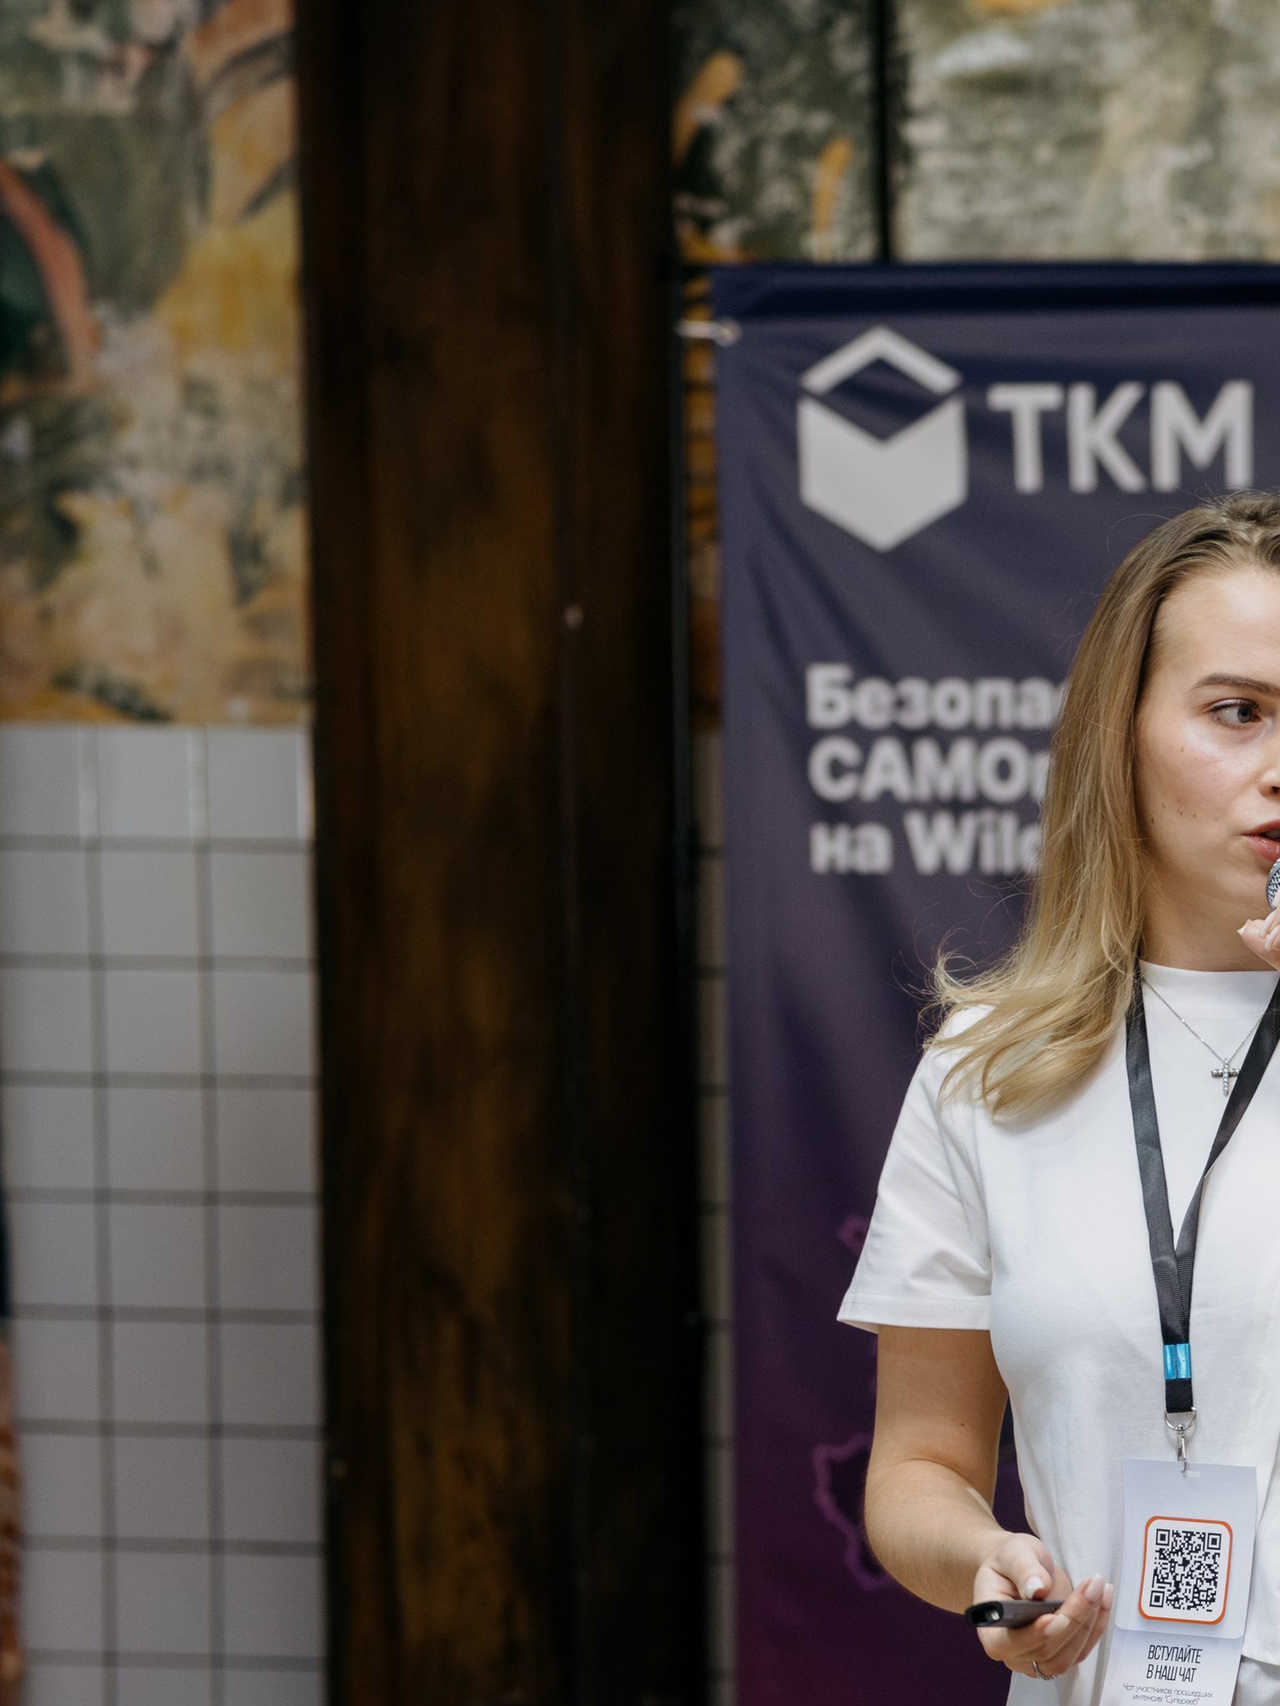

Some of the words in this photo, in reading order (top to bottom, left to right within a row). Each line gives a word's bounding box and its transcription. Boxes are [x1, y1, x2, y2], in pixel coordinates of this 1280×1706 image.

[809, 822, 893, 876] на
[1147, 1644, 1203, 1664] ВСТУПАЙТЕ
[1146, 1664, 1155, 1679] В
[1154, 1665, 1179, 1681] НАШ
[1178, 1667, 1198, 1683] ЧАТ
